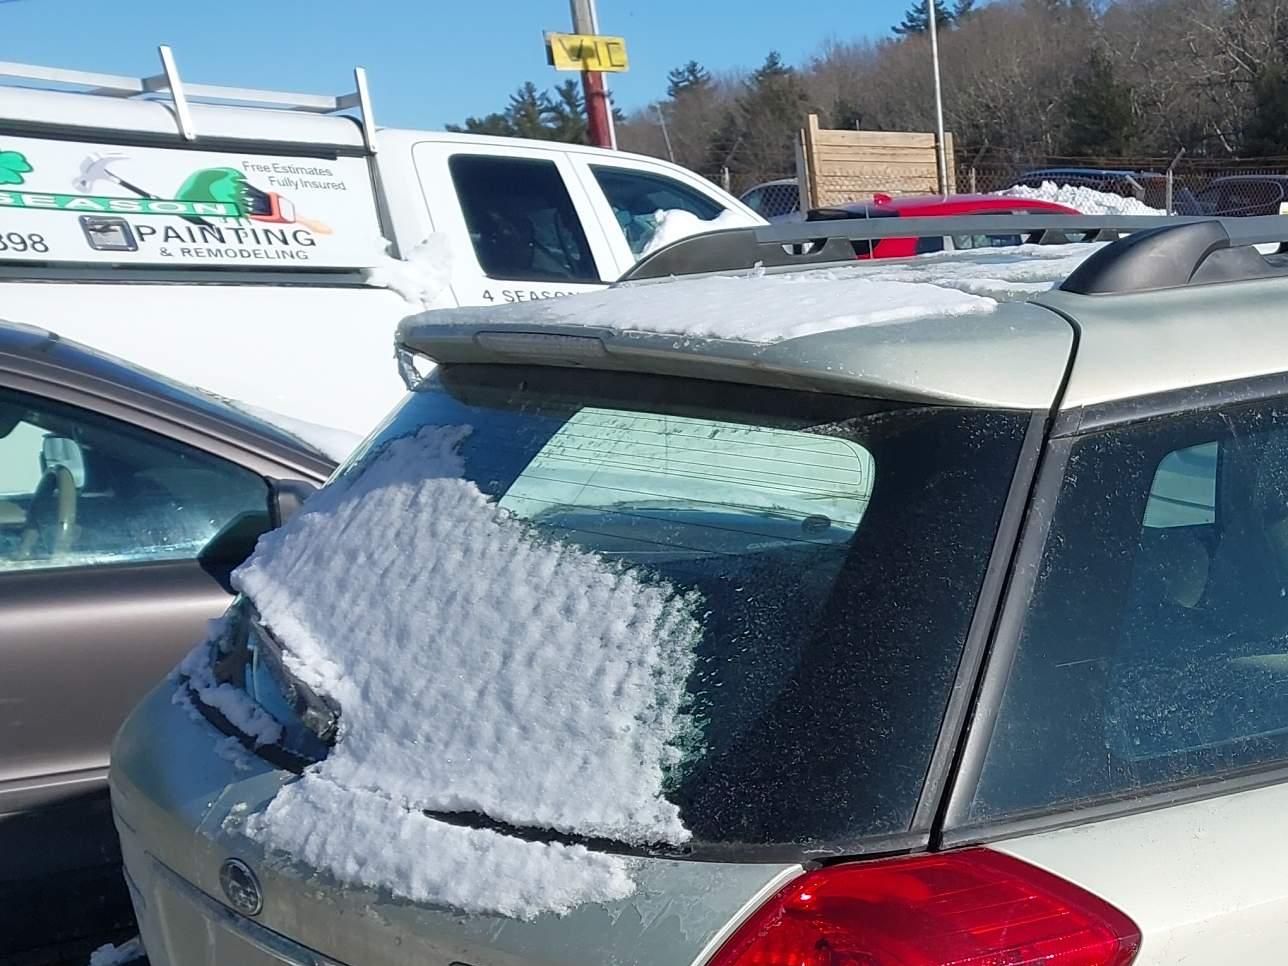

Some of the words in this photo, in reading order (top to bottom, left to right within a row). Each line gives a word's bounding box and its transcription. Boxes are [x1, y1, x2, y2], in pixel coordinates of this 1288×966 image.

[241, 161, 270, 173] Free
[272, 163, 333, 177] Estimates
[268, 176, 300, 190] Fully
[300, 178, 347, 191] Insured
[135, 225, 317, 247] PAINTING
[160, 247, 173, 257] &
[181, 247, 310, 260] REMODELING
[482, 289, 495, 303] 4
[502, 290, 580, 304] SEAS
